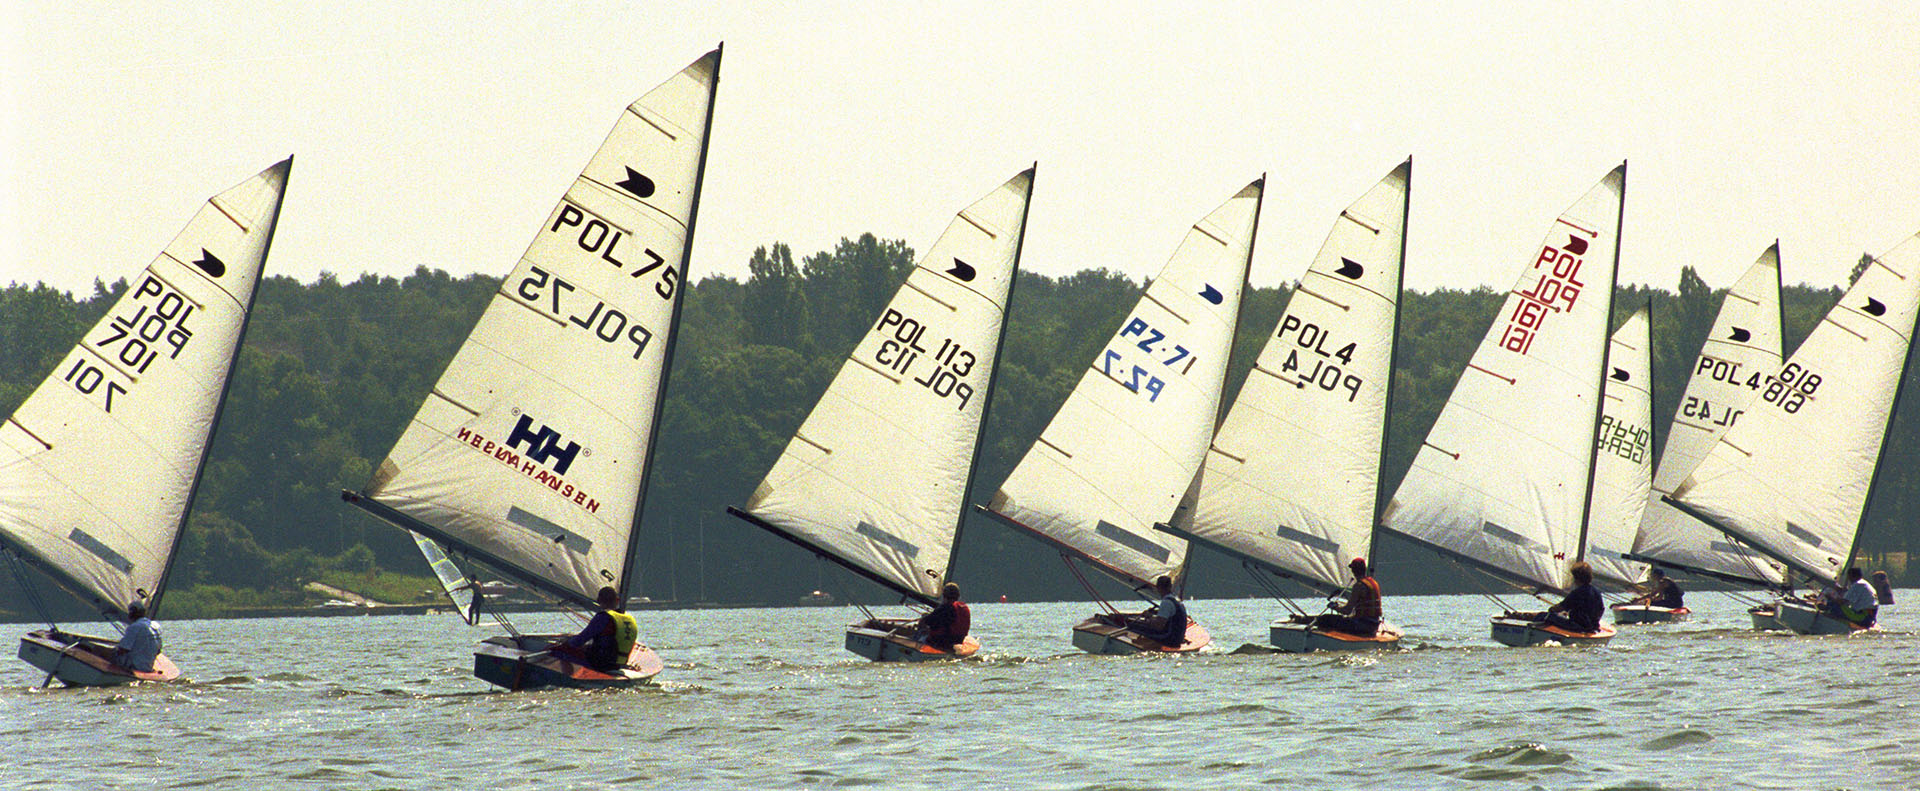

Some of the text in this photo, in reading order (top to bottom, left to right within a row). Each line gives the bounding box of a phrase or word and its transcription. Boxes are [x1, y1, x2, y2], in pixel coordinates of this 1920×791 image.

[550, 203, 679, 301] POL 75
[1534, 245, 1584, 288] POL
[133, 275, 193, 338] POL
[1510, 298, 1548, 331] 161
[96, 322, 158, 374] 701
[876, 308, 976, 377] POL 113
[1277, 314, 1358, 366] POL 4
[1697, 356, 1740, 386] POL
[1780, 362, 1822, 395] 618
